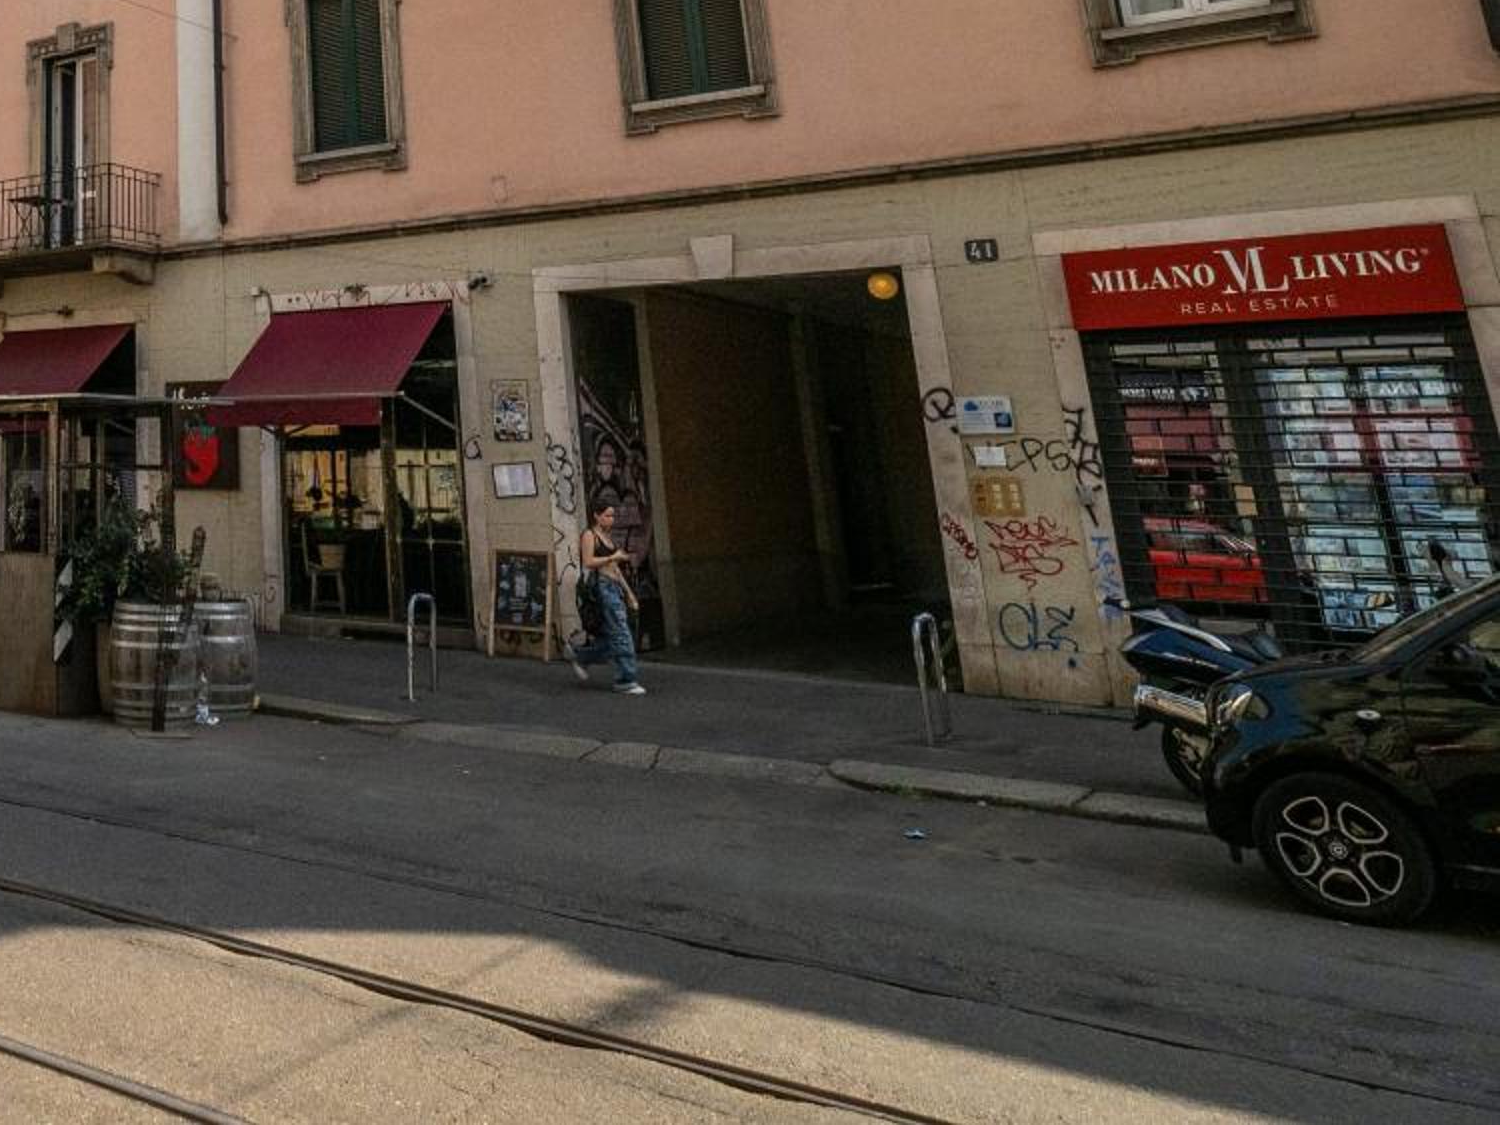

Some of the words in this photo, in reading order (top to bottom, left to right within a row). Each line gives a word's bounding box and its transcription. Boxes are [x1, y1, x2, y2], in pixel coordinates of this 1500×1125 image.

[970, 242, 992, 260] 41
[1091, 263, 1215, 294] MILANO
[1180, 301, 1237, 315] REAL
[1249, 293, 1339, 313] ESTATE
